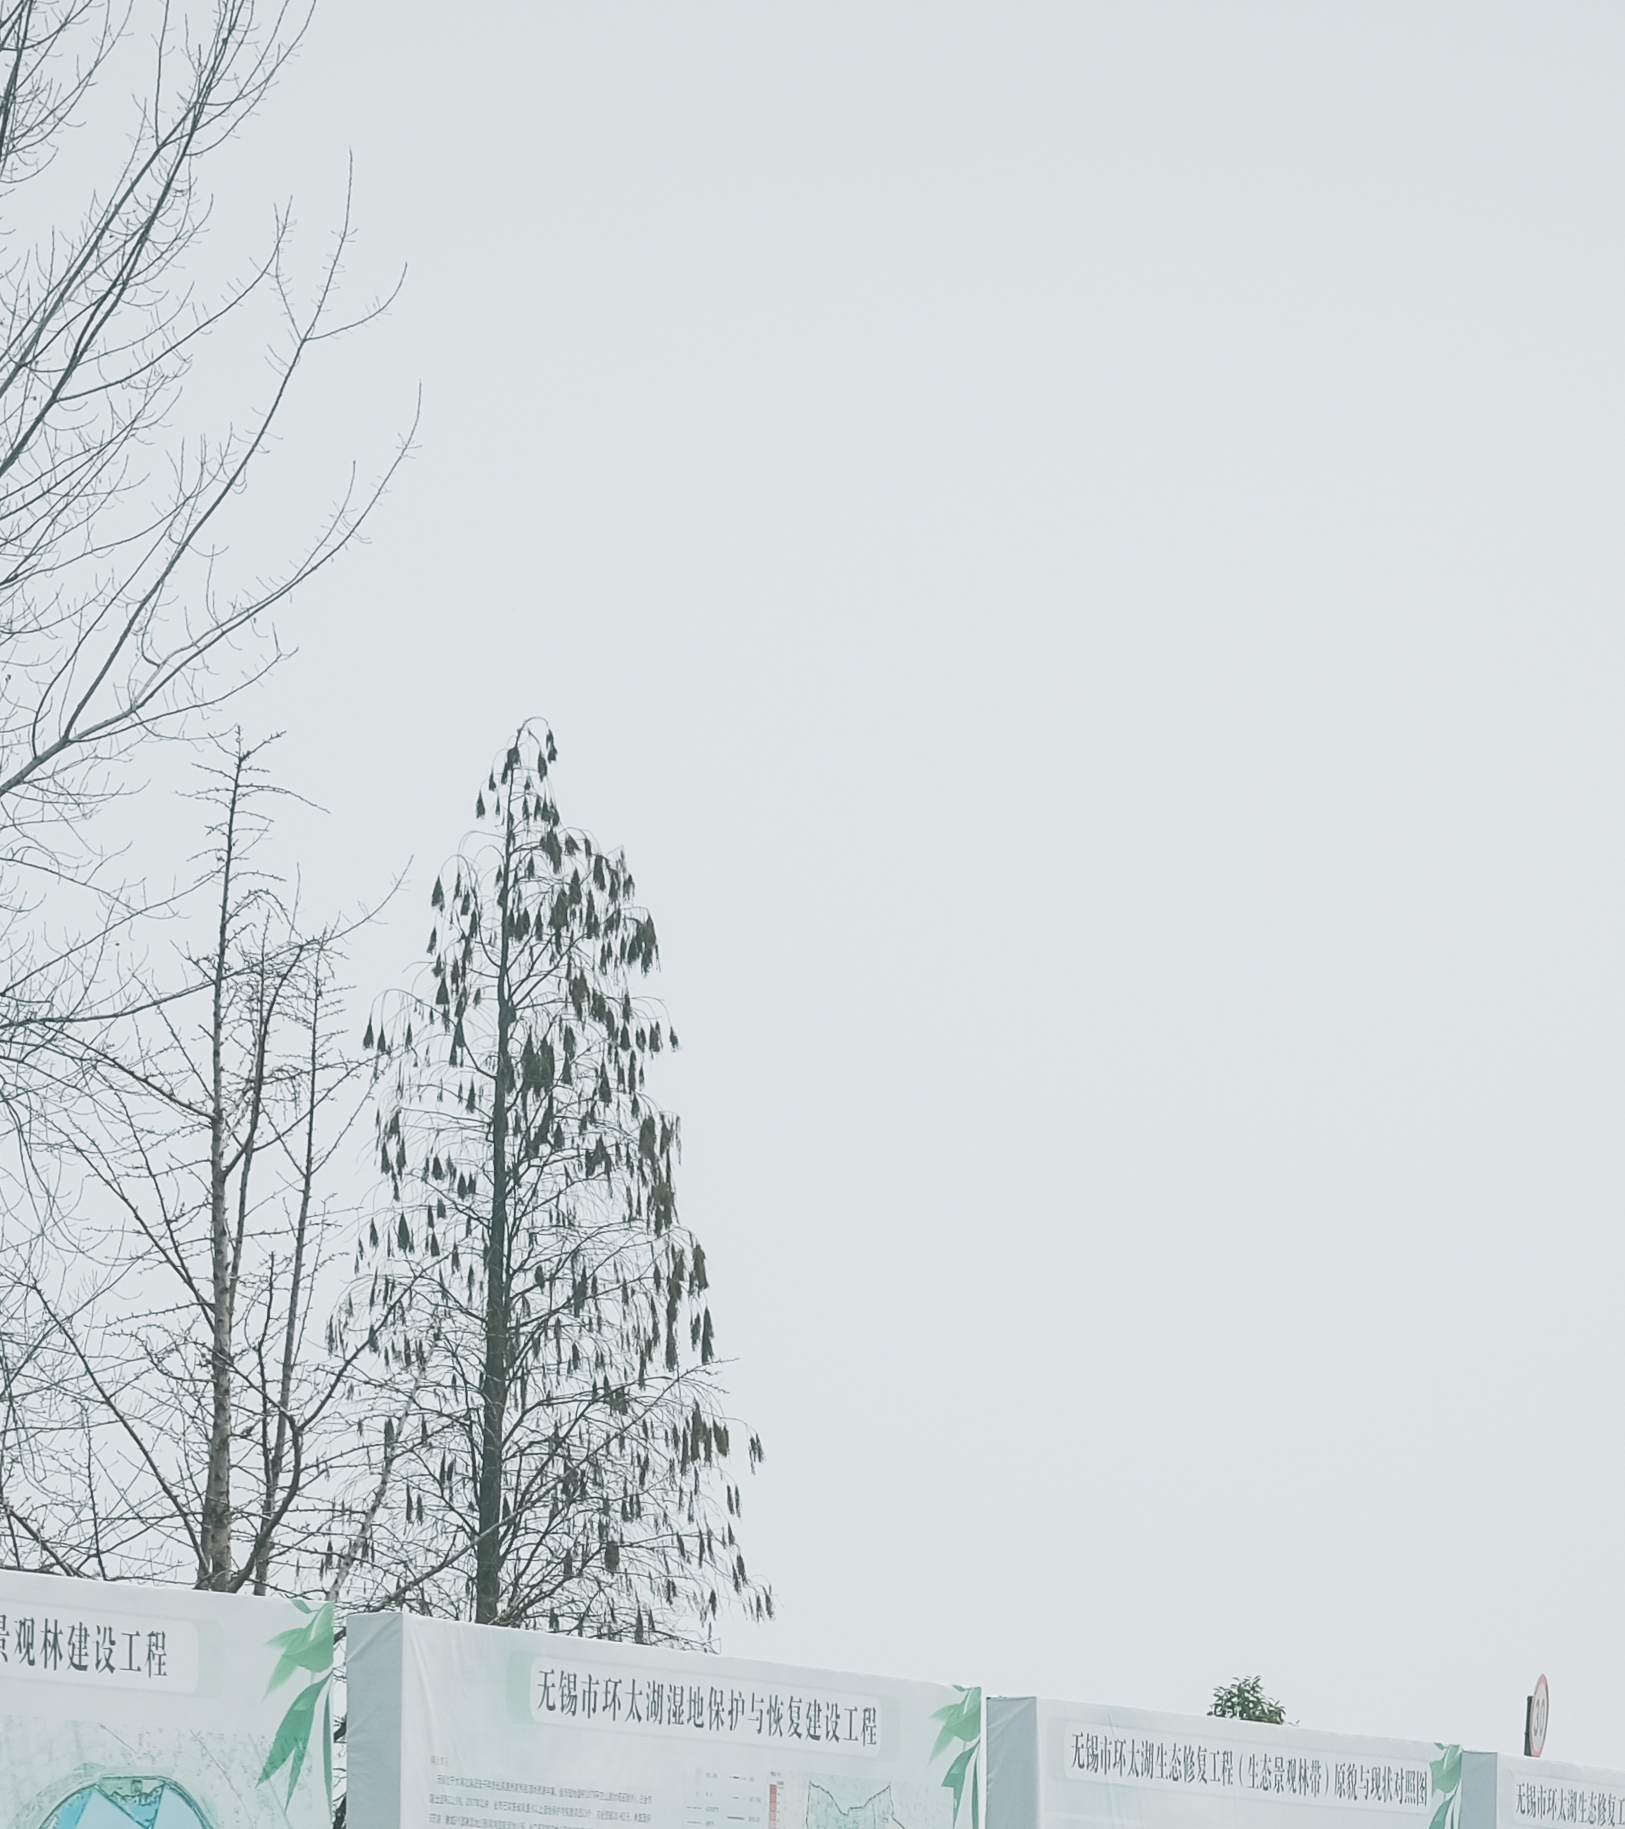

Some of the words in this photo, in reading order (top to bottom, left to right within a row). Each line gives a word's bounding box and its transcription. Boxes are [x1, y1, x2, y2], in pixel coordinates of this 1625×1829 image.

[536, 1668, 878, 1748] 无锡市环太湖湿地保护与恢复建设工程
